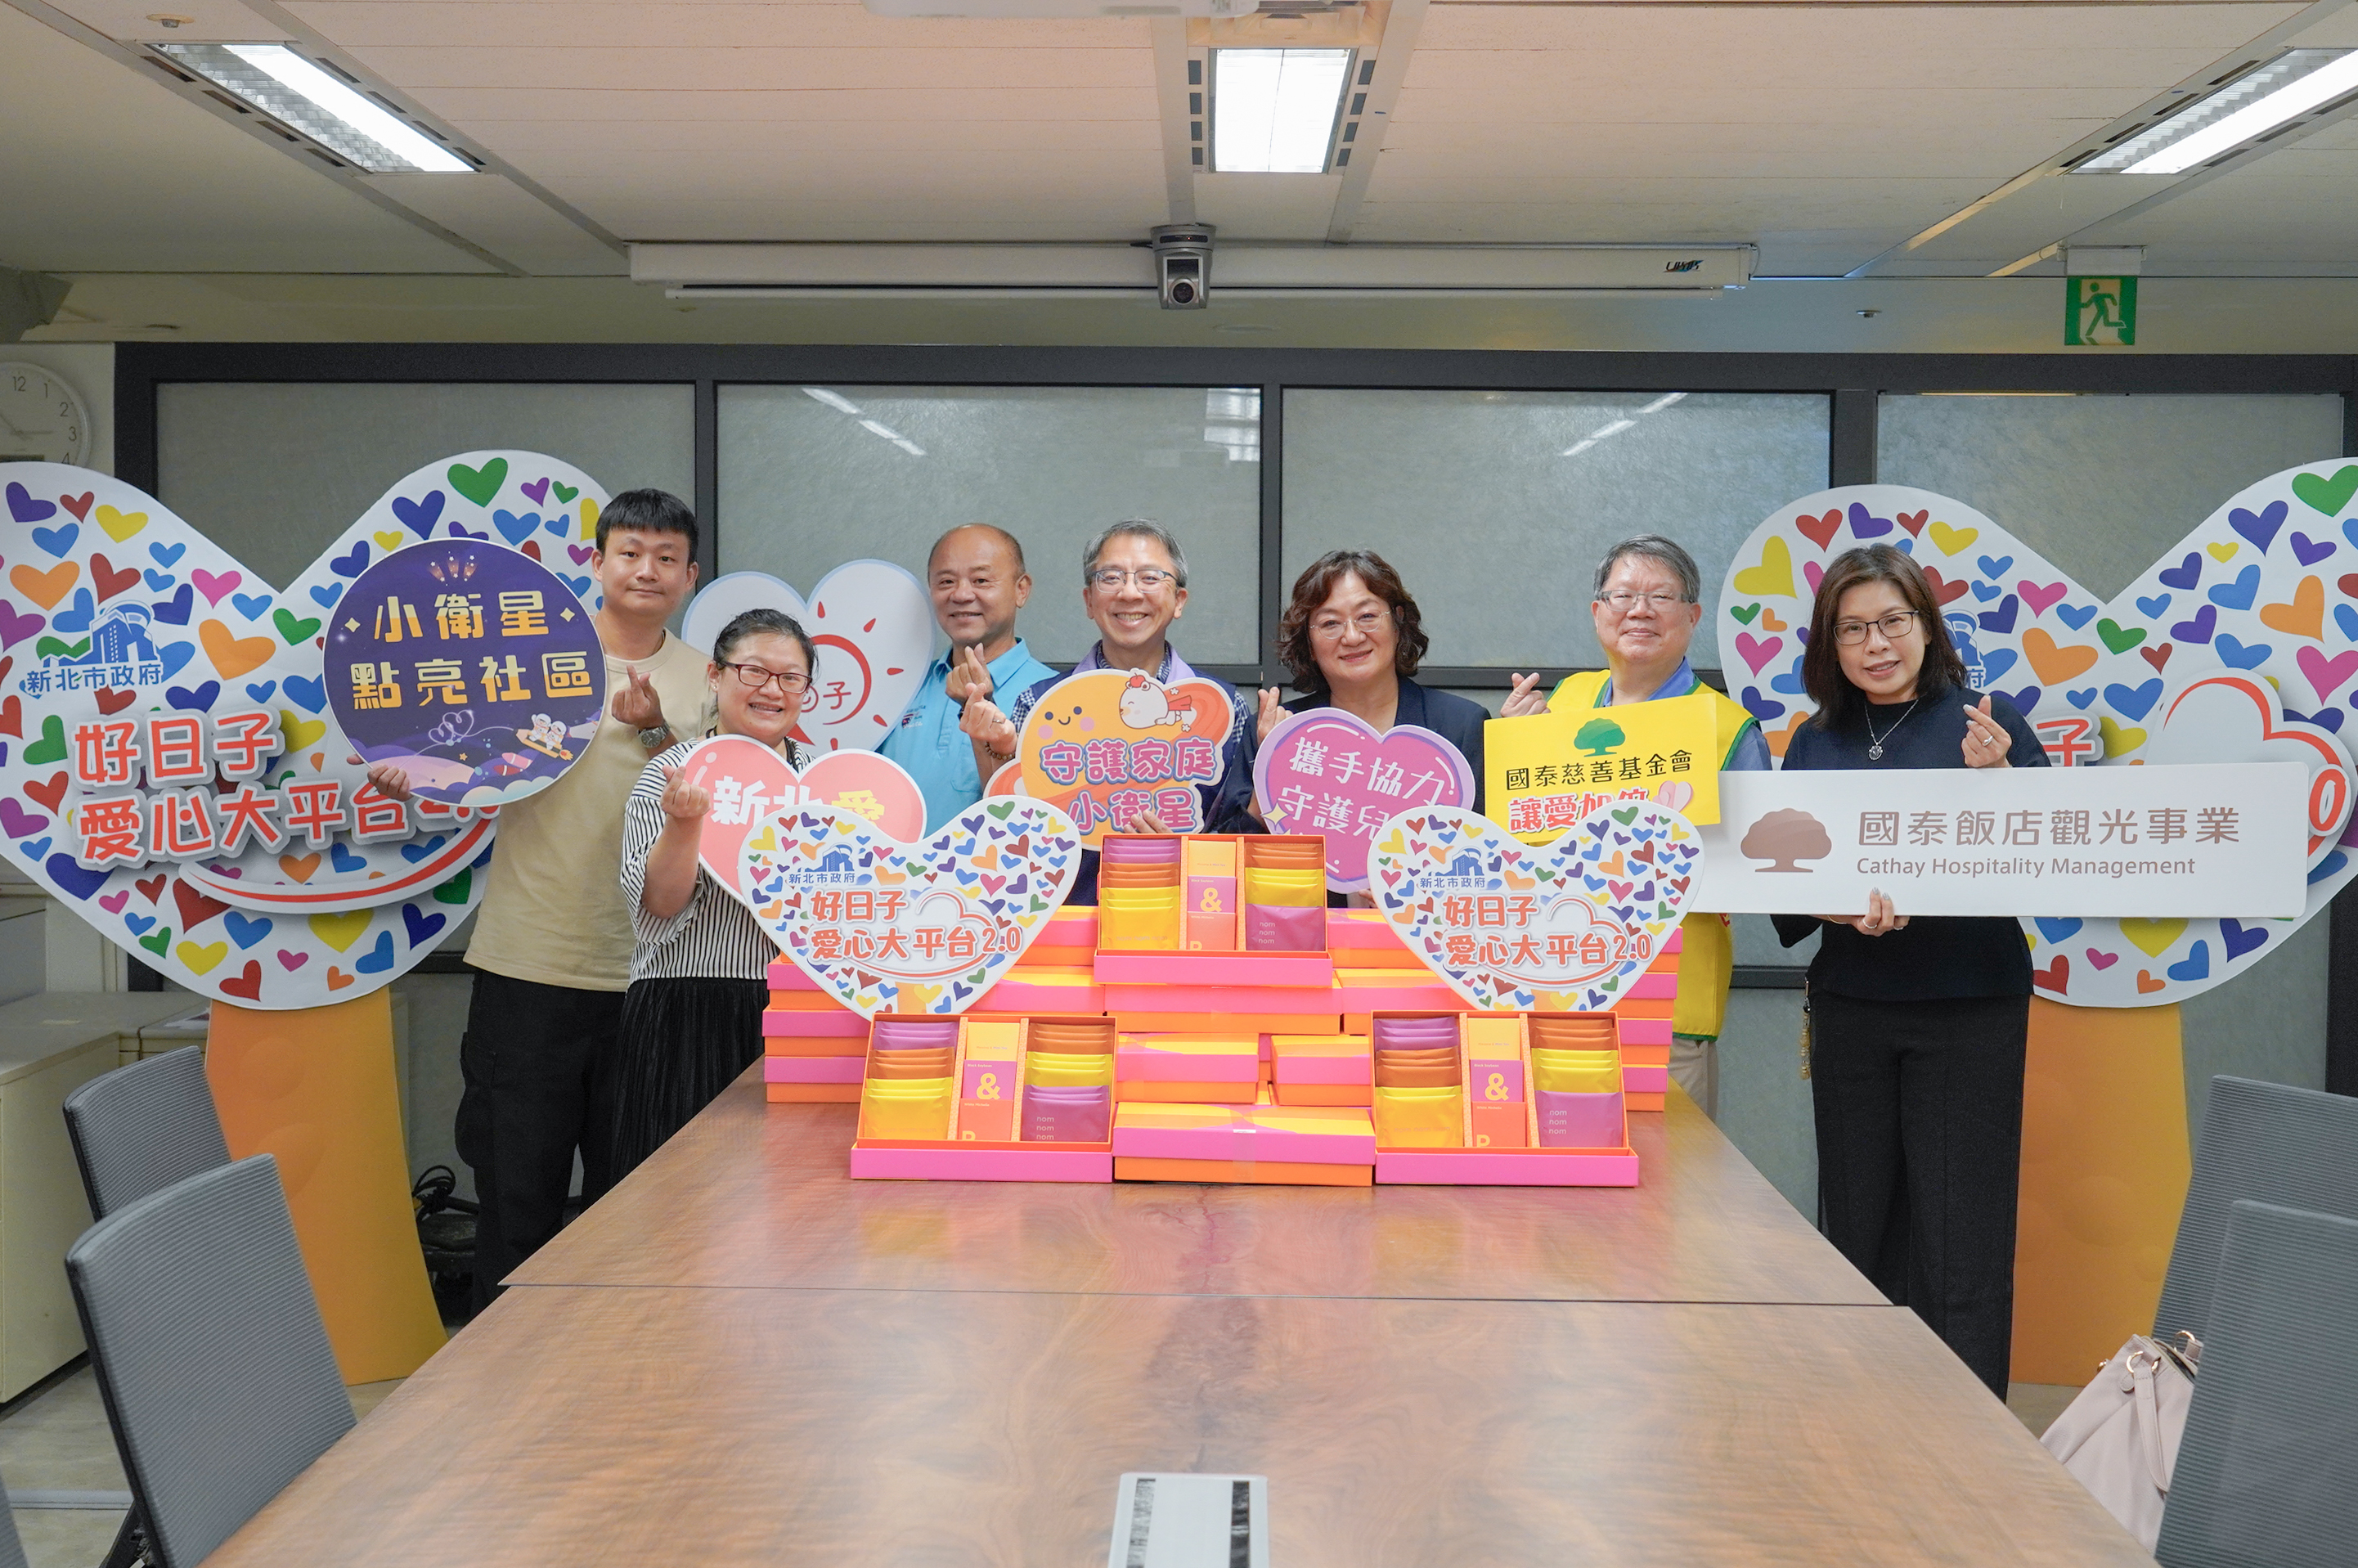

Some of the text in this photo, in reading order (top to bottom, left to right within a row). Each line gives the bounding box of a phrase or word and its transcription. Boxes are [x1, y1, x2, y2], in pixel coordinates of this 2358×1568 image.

[13, 376, 26, 392] 12
[43, 383, 48, 398] 1
[59, 402, 69, 417] 2
[68, 426, 77, 442] 3
[374, 591, 550, 642] 小衛星
[27, 663, 162, 693] 新北市政府
[350, 651, 593, 709] 點亮社區
[74, 712, 274, 783] 好日子
[1041, 737, 1216, 783] 守護家庭
[1289, 736, 1445, 806] 攜手協力
[1506, 749, 1693, 791] 國泰慈善基金會
[1068, 788, 1195, 833] 小衛星
[1857, 806, 2240, 846] 國泰飯店觀光事業
[788, 872, 856, 884] 新北市政府
[1857, 856, 2195, 878] Cathay Hospitality Management
[1420, 877, 1486, 888] 新北市政府
[810, 890, 907, 922] 好日子
[1200, 887, 1222, 912] &
[1442, 895, 1538, 927] 好日子
[976, 1072, 1001, 1100] &
[1484, 1072, 1509, 1101] &
